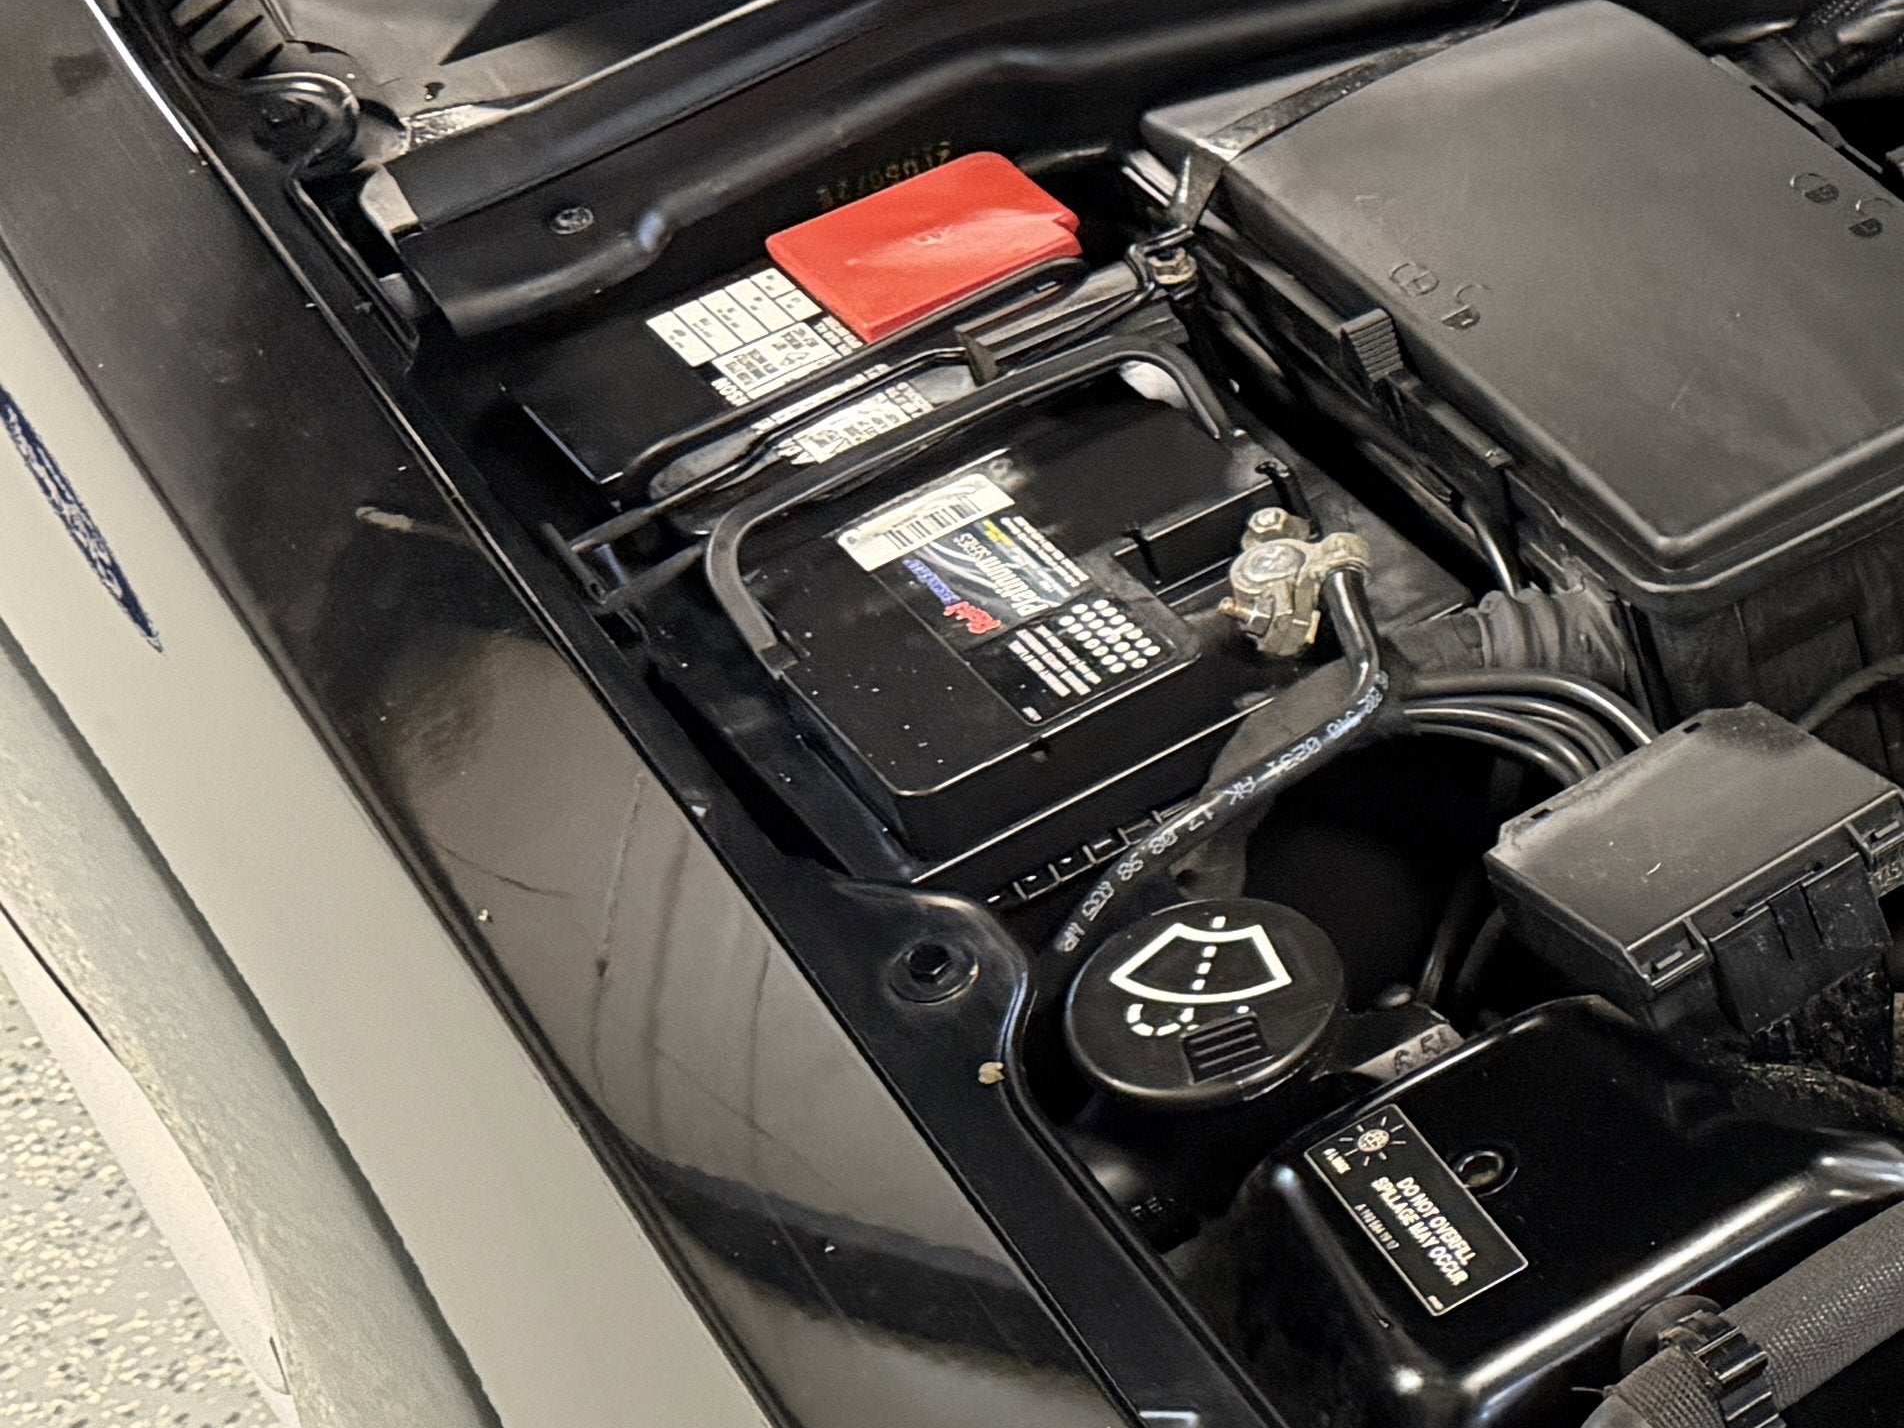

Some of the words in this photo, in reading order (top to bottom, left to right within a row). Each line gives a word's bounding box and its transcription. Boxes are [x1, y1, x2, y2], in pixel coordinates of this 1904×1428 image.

[974, 555, 1048, 617] Platinum
[1370, 1176, 1420, 1227] SPILLAGE
[1408, 1220, 1439, 1248] MAY
[1427, 1244, 1469, 1286] OCCUR
[1395, 1175, 1420, 1198] DO
[1410, 1191, 1440, 1220] NOT
[1428, 1214, 1476, 1266] OVERFILL
